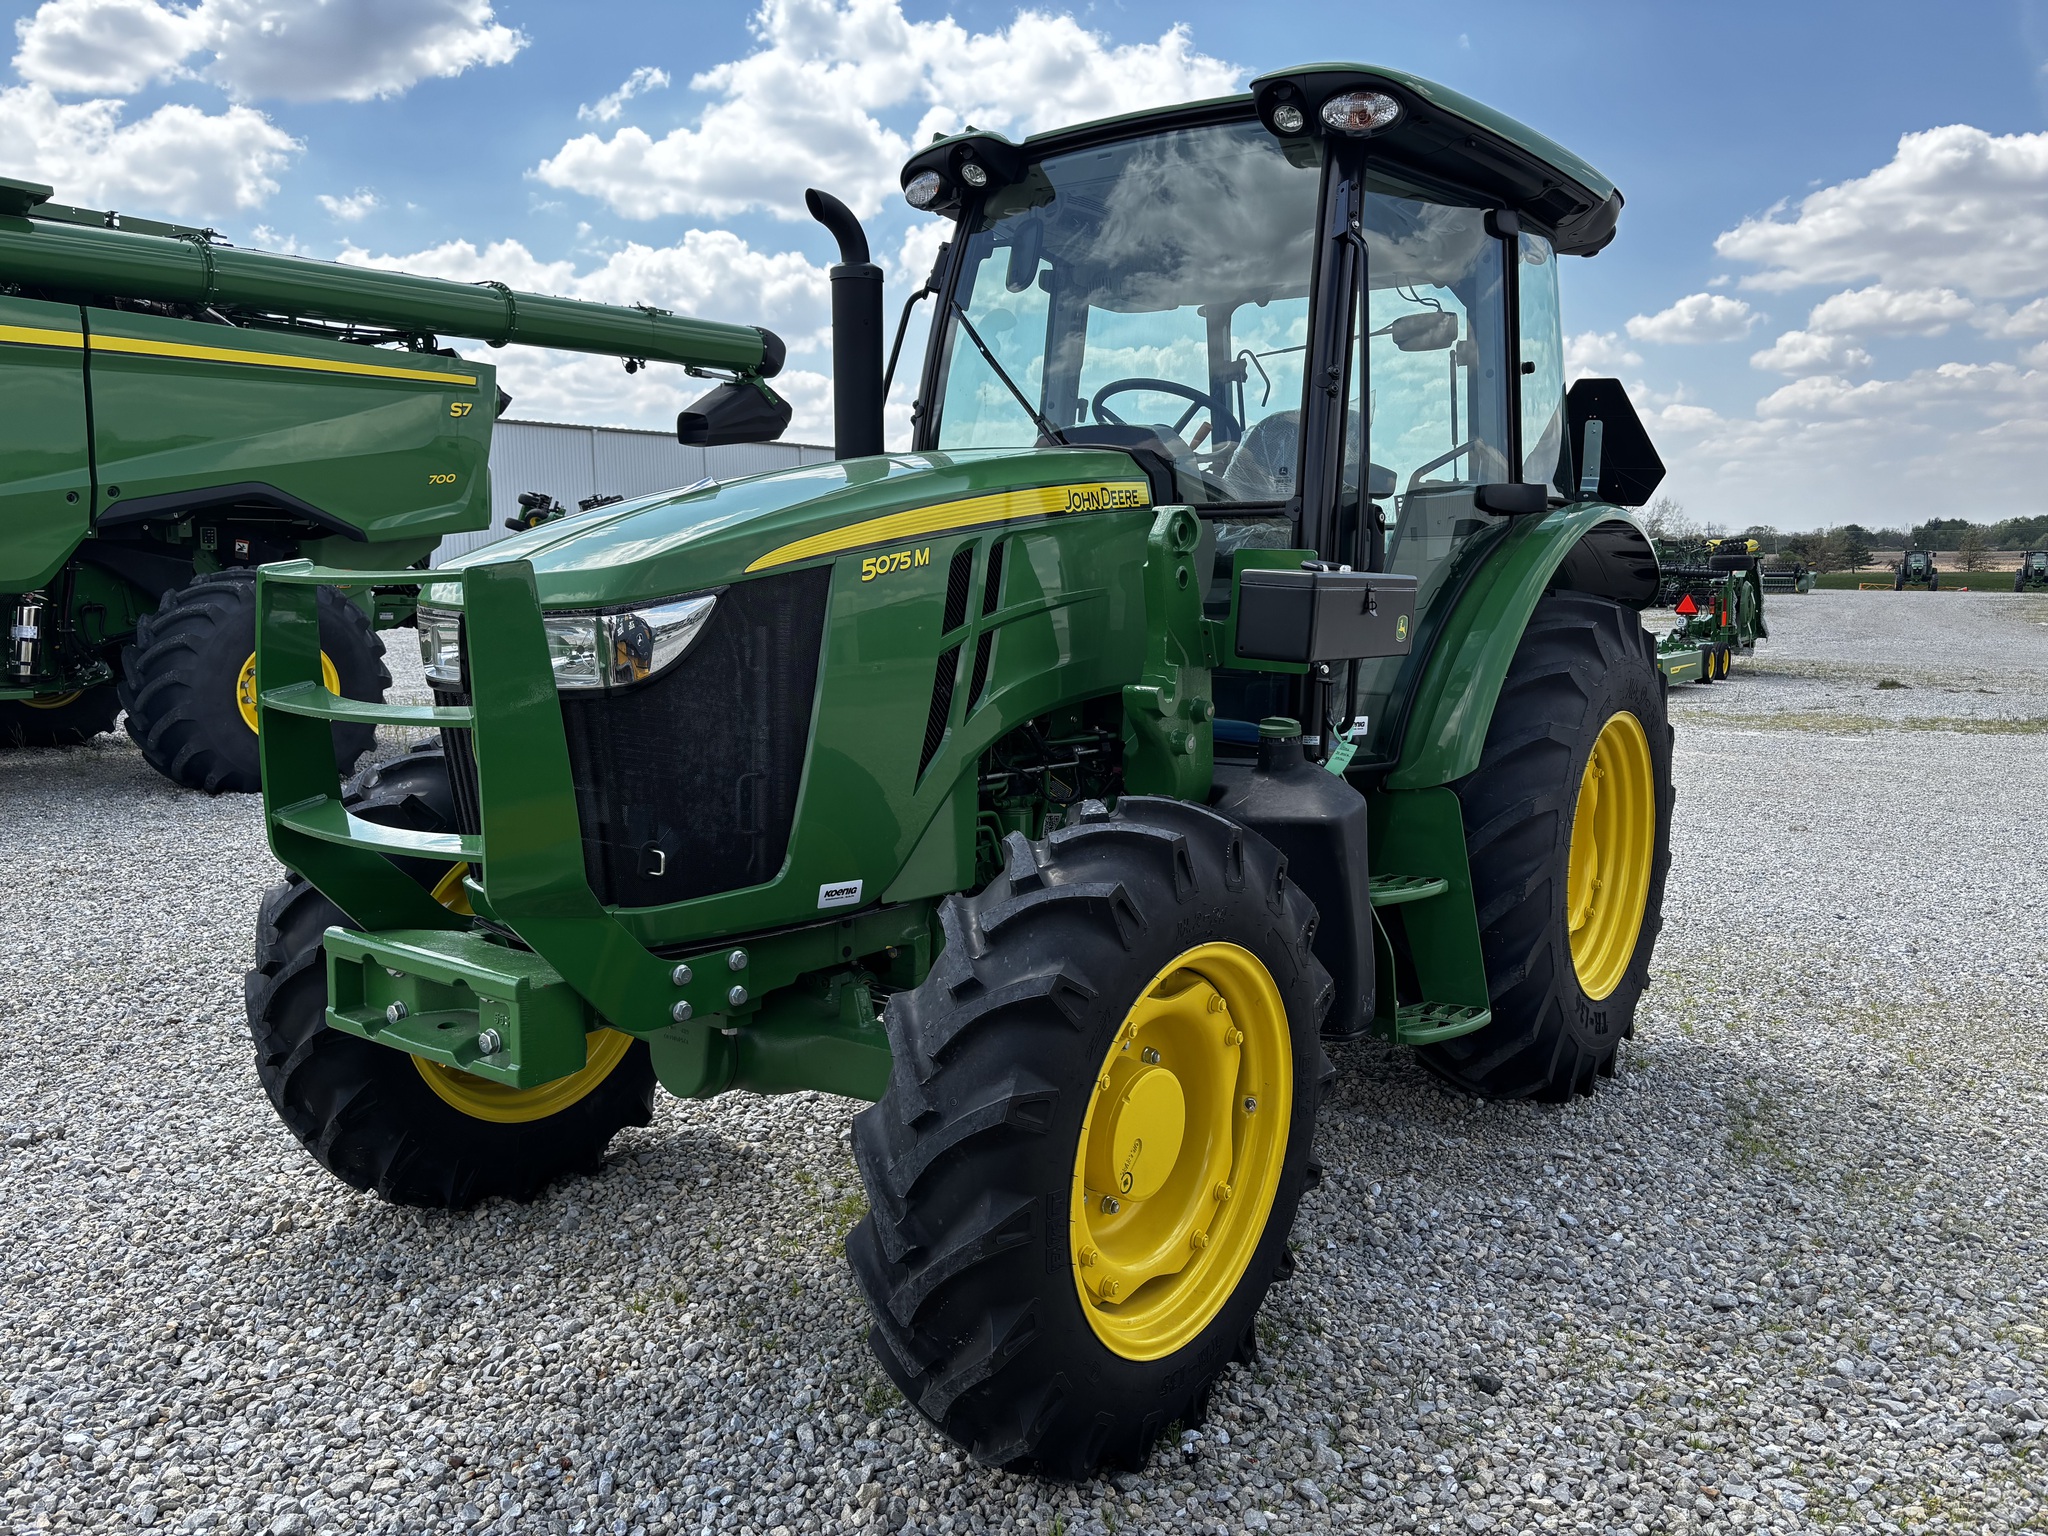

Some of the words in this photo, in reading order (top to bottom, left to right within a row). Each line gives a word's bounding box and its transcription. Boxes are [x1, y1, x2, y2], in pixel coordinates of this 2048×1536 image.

[449, 402, 473, 418] S7
[428, 473, 457, 485] 700
[1064, 489, 1101, 512] JOHN
[1100, 487, 1140, 509] DEERE
